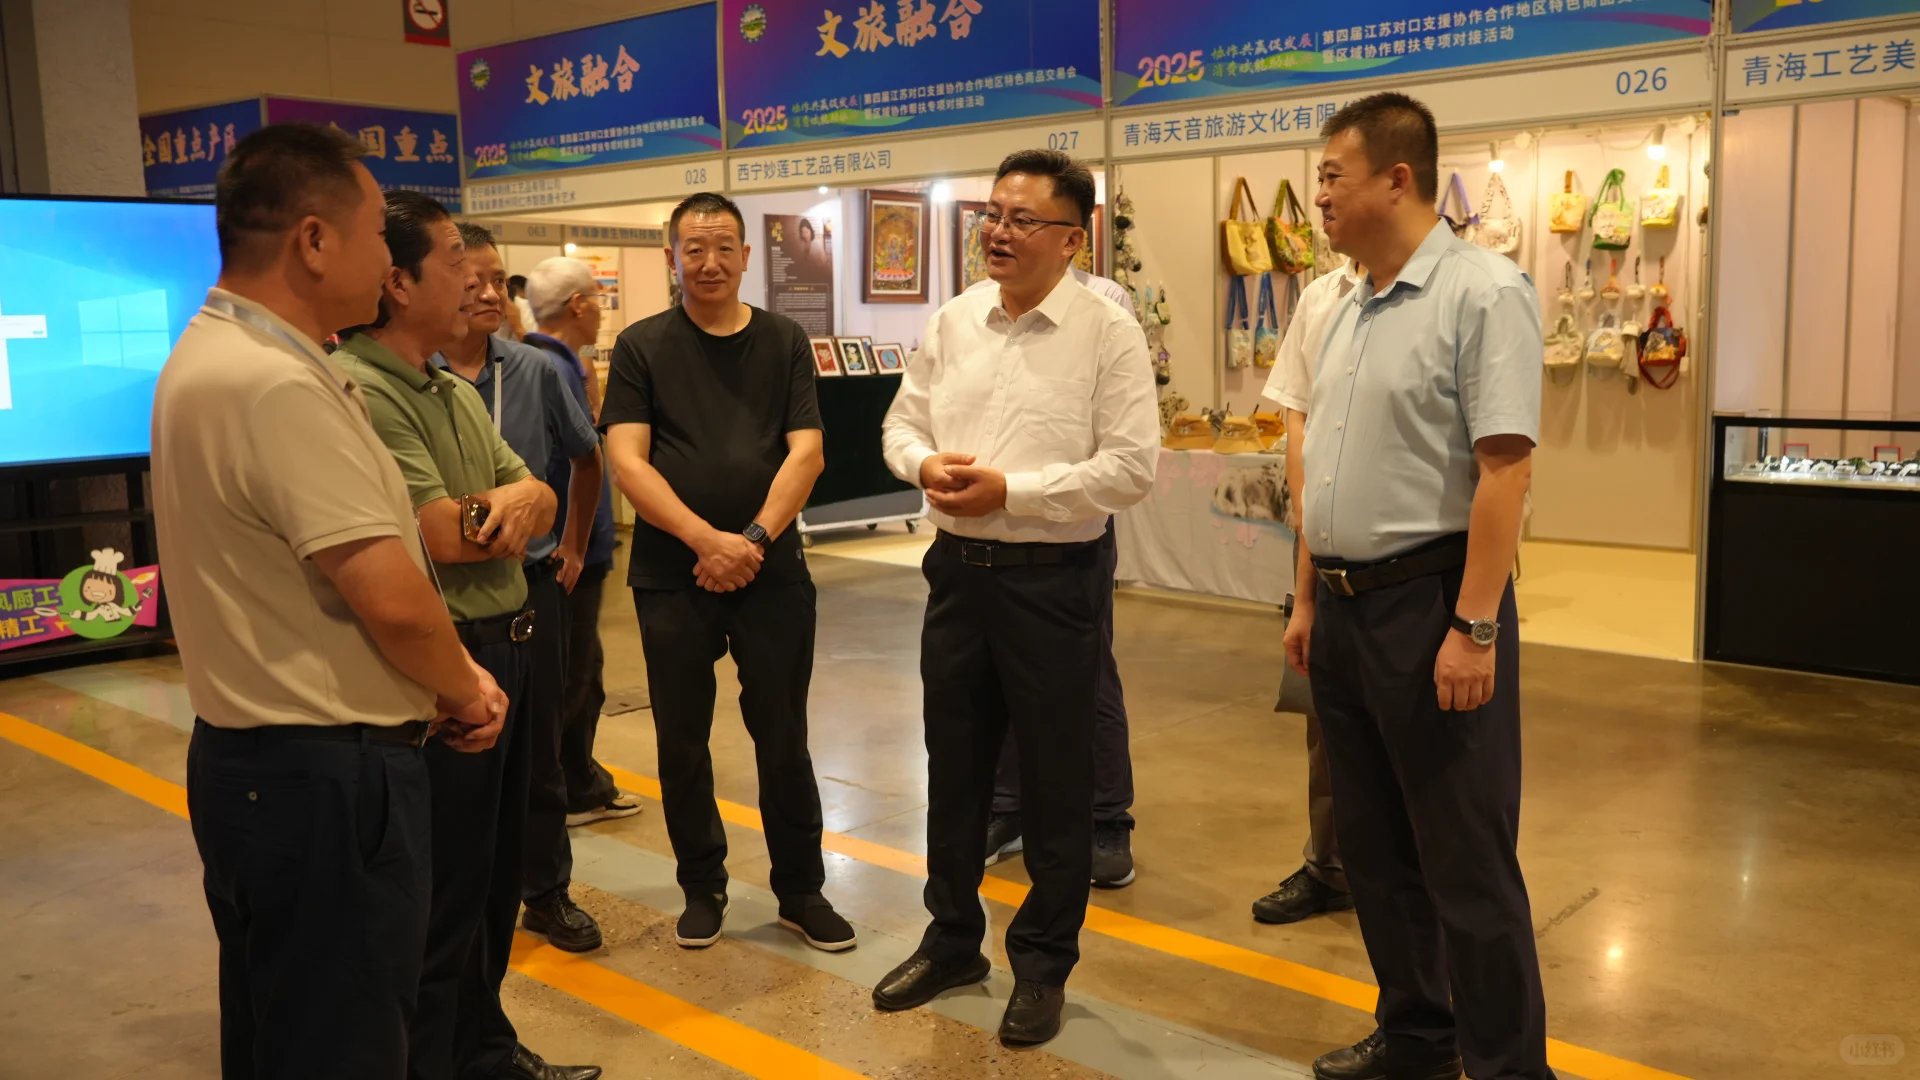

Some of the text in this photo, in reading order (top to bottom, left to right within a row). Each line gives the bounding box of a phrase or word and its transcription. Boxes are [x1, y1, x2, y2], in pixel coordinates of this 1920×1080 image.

[814, 0, 984, 59] 文旅融合
[1322, 25, 1514, 65] 暨区域协作帮扶专项对接活动
[524, 44, 641, 106] 文旅融合
[1137, 50, 1205, 90] 2025
[1616, 67, 1668, 95] 026
[1741, 38, 1916, 88] 青海工艺美
[863, 65, 1077, 106] 第四届江苏对口支援协作合作地区特色商品交易会
[742, 105, 789, 135] 2025
[1123, 101, 1353, 147] 青海天音旅游文化有限
[328, 119, 455, 164] 国重点
[474, 143, 508, 168] 2025
[1048, 131, 1079, 151] 027
[685, 168, 707, 185] 028
[736, 150, 892, 182] 西宁妙莲工艺品有限公司
